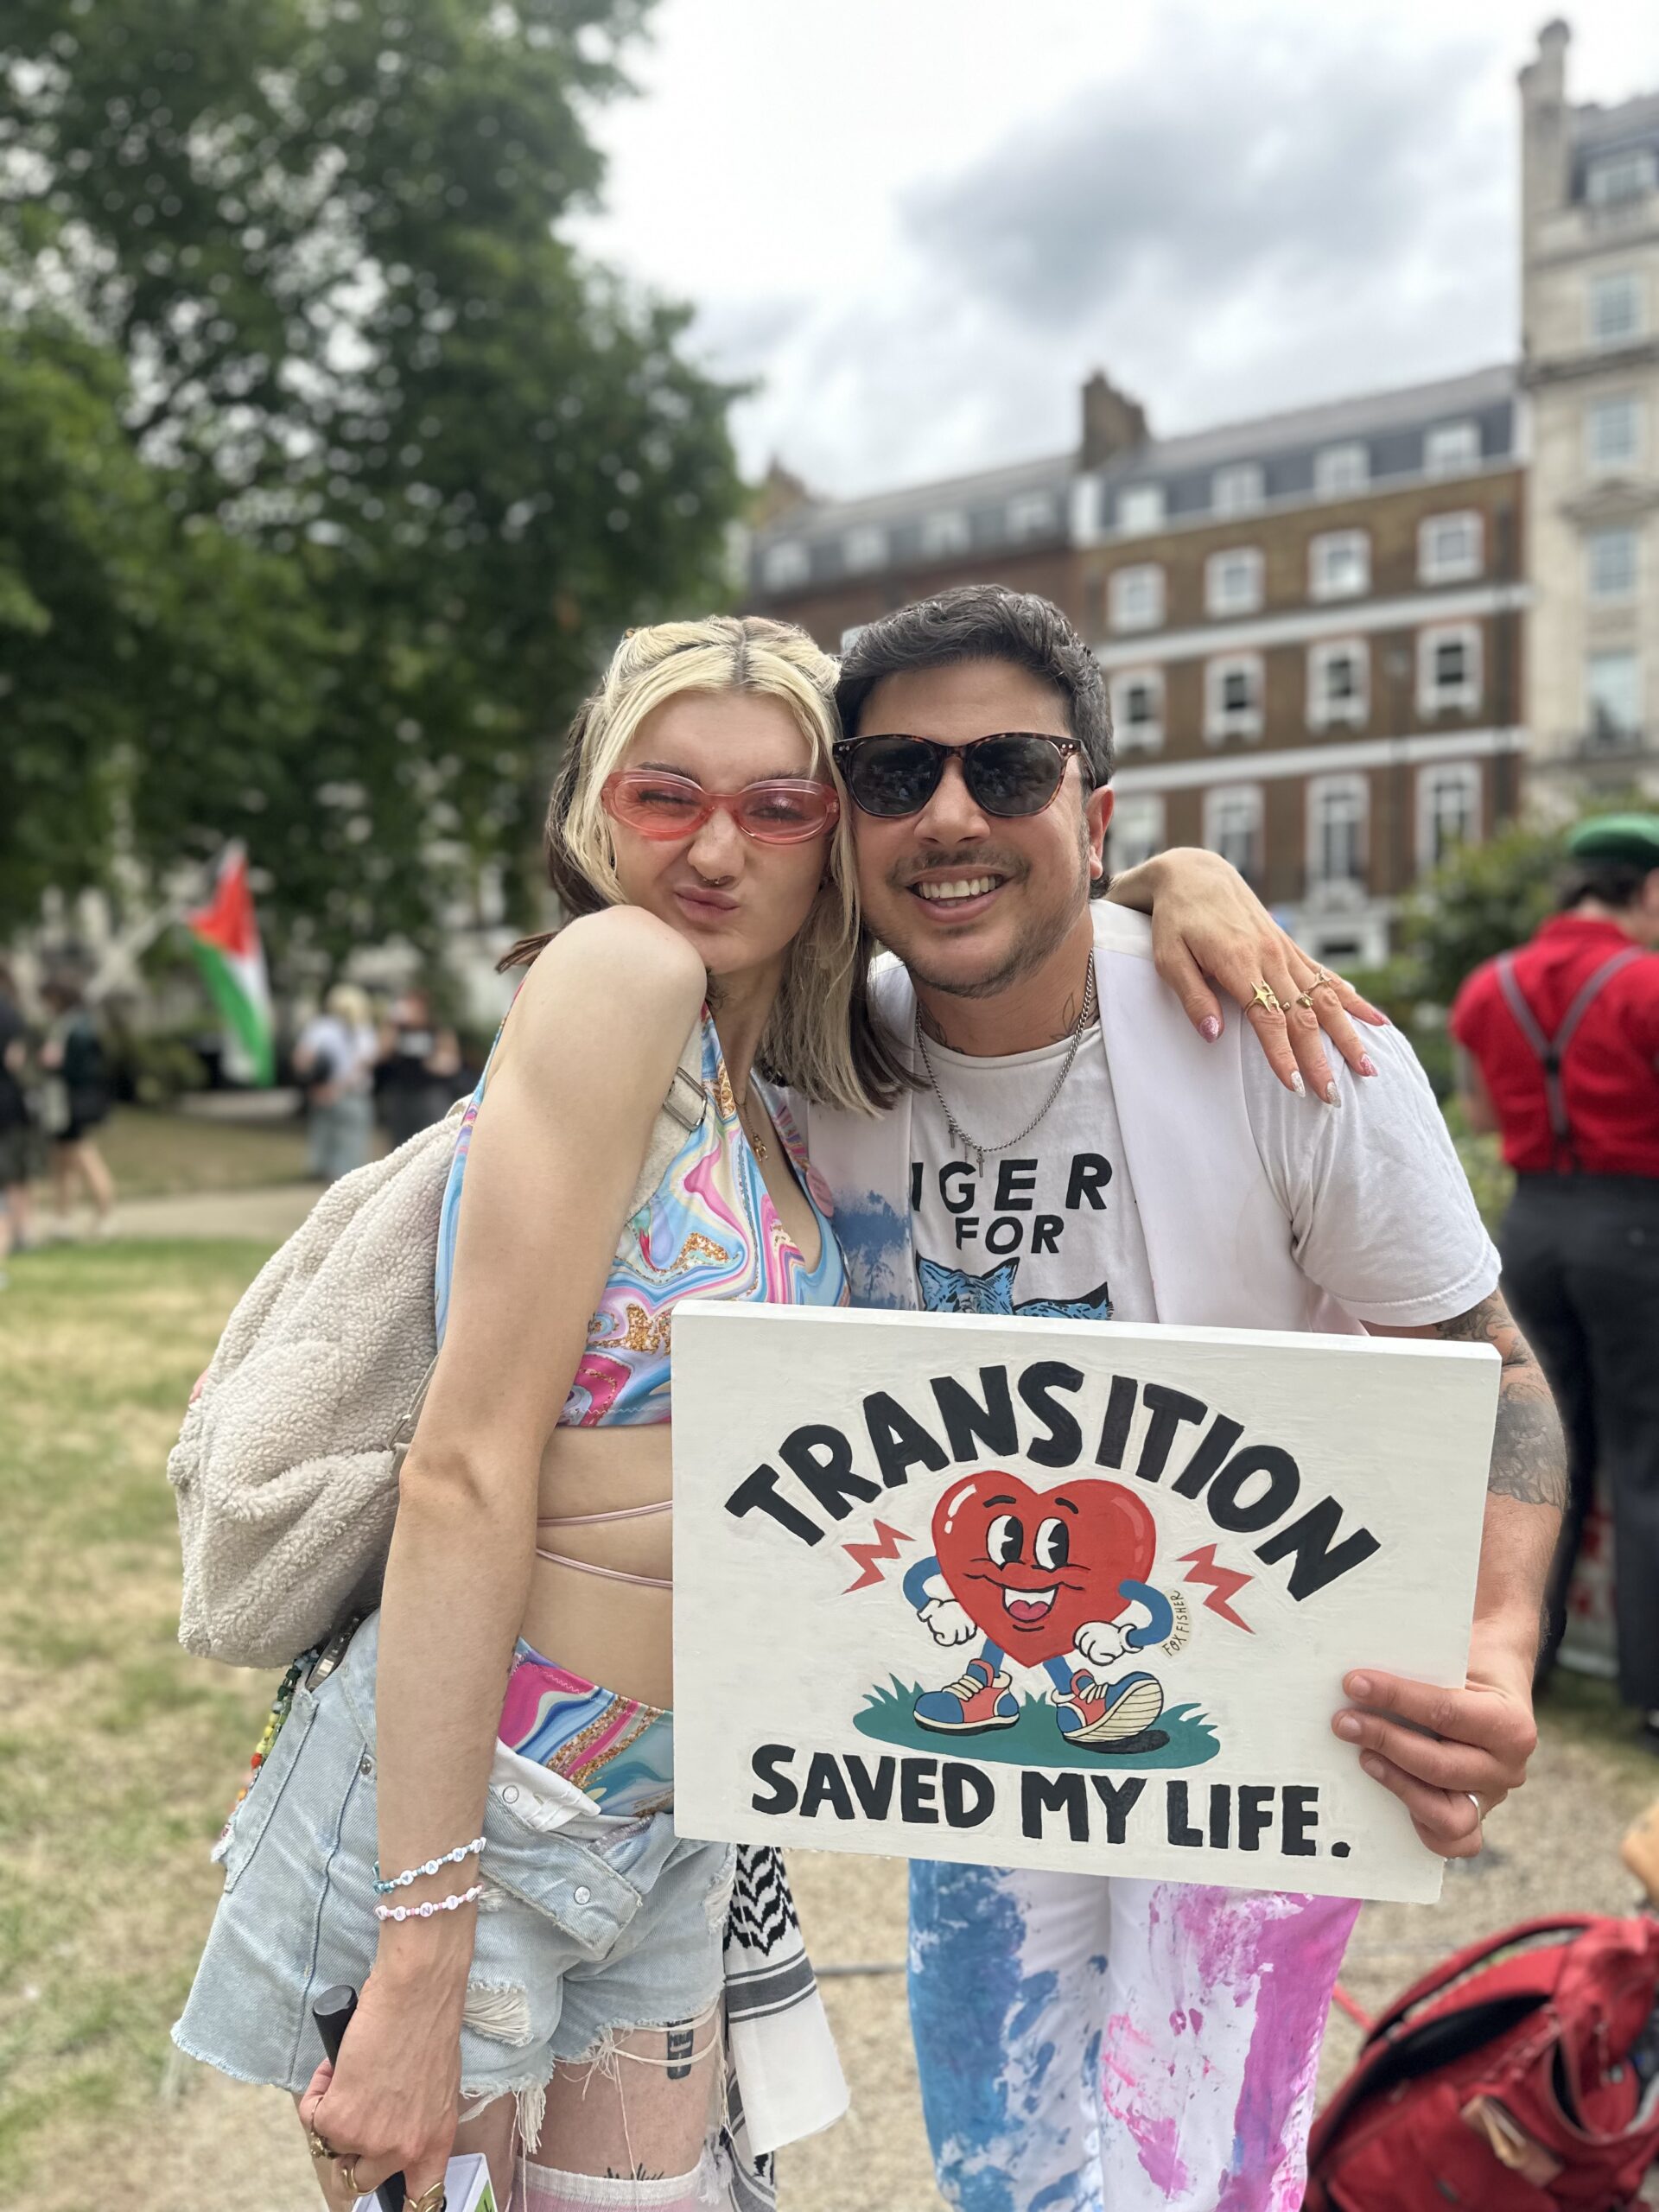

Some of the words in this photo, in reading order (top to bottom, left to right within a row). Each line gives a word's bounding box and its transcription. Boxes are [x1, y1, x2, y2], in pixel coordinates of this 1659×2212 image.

[912, 1154, 1112, 1213] IGER
[956, 1215, 1064, 1254] FOR
[725, 1361, 1381, 1601] TRANSITION
[1170, 1590, 1190, 1633] FISHER
[1161, 1634, 1187, 1656] FOX
[753, 1745, 995, 1827] SAVED
[1021, 1771, 1147, 1844] MY
[1166, 1781, 1351, 1857] LIFE.
